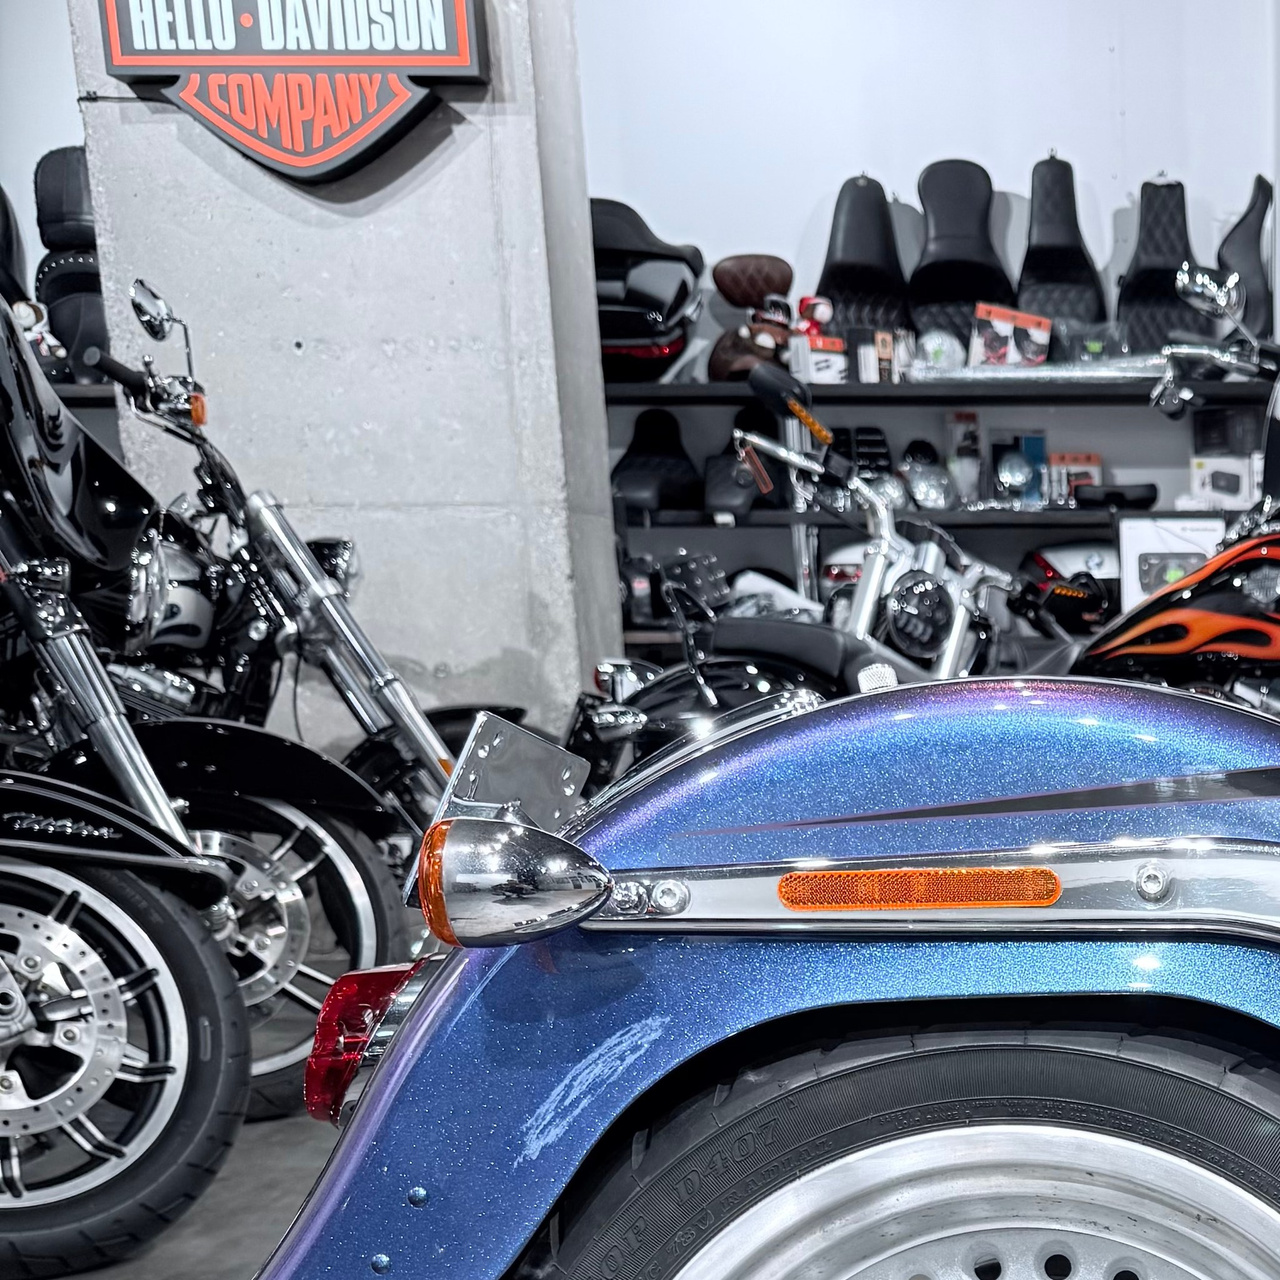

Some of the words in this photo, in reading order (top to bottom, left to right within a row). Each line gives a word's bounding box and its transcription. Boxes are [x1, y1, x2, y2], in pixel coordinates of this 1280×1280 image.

[260, 0, 447, 50] DAVIDSON
[208, 73, 382, 152] COMPANY
[674, 1117, 778, 1206] D407
